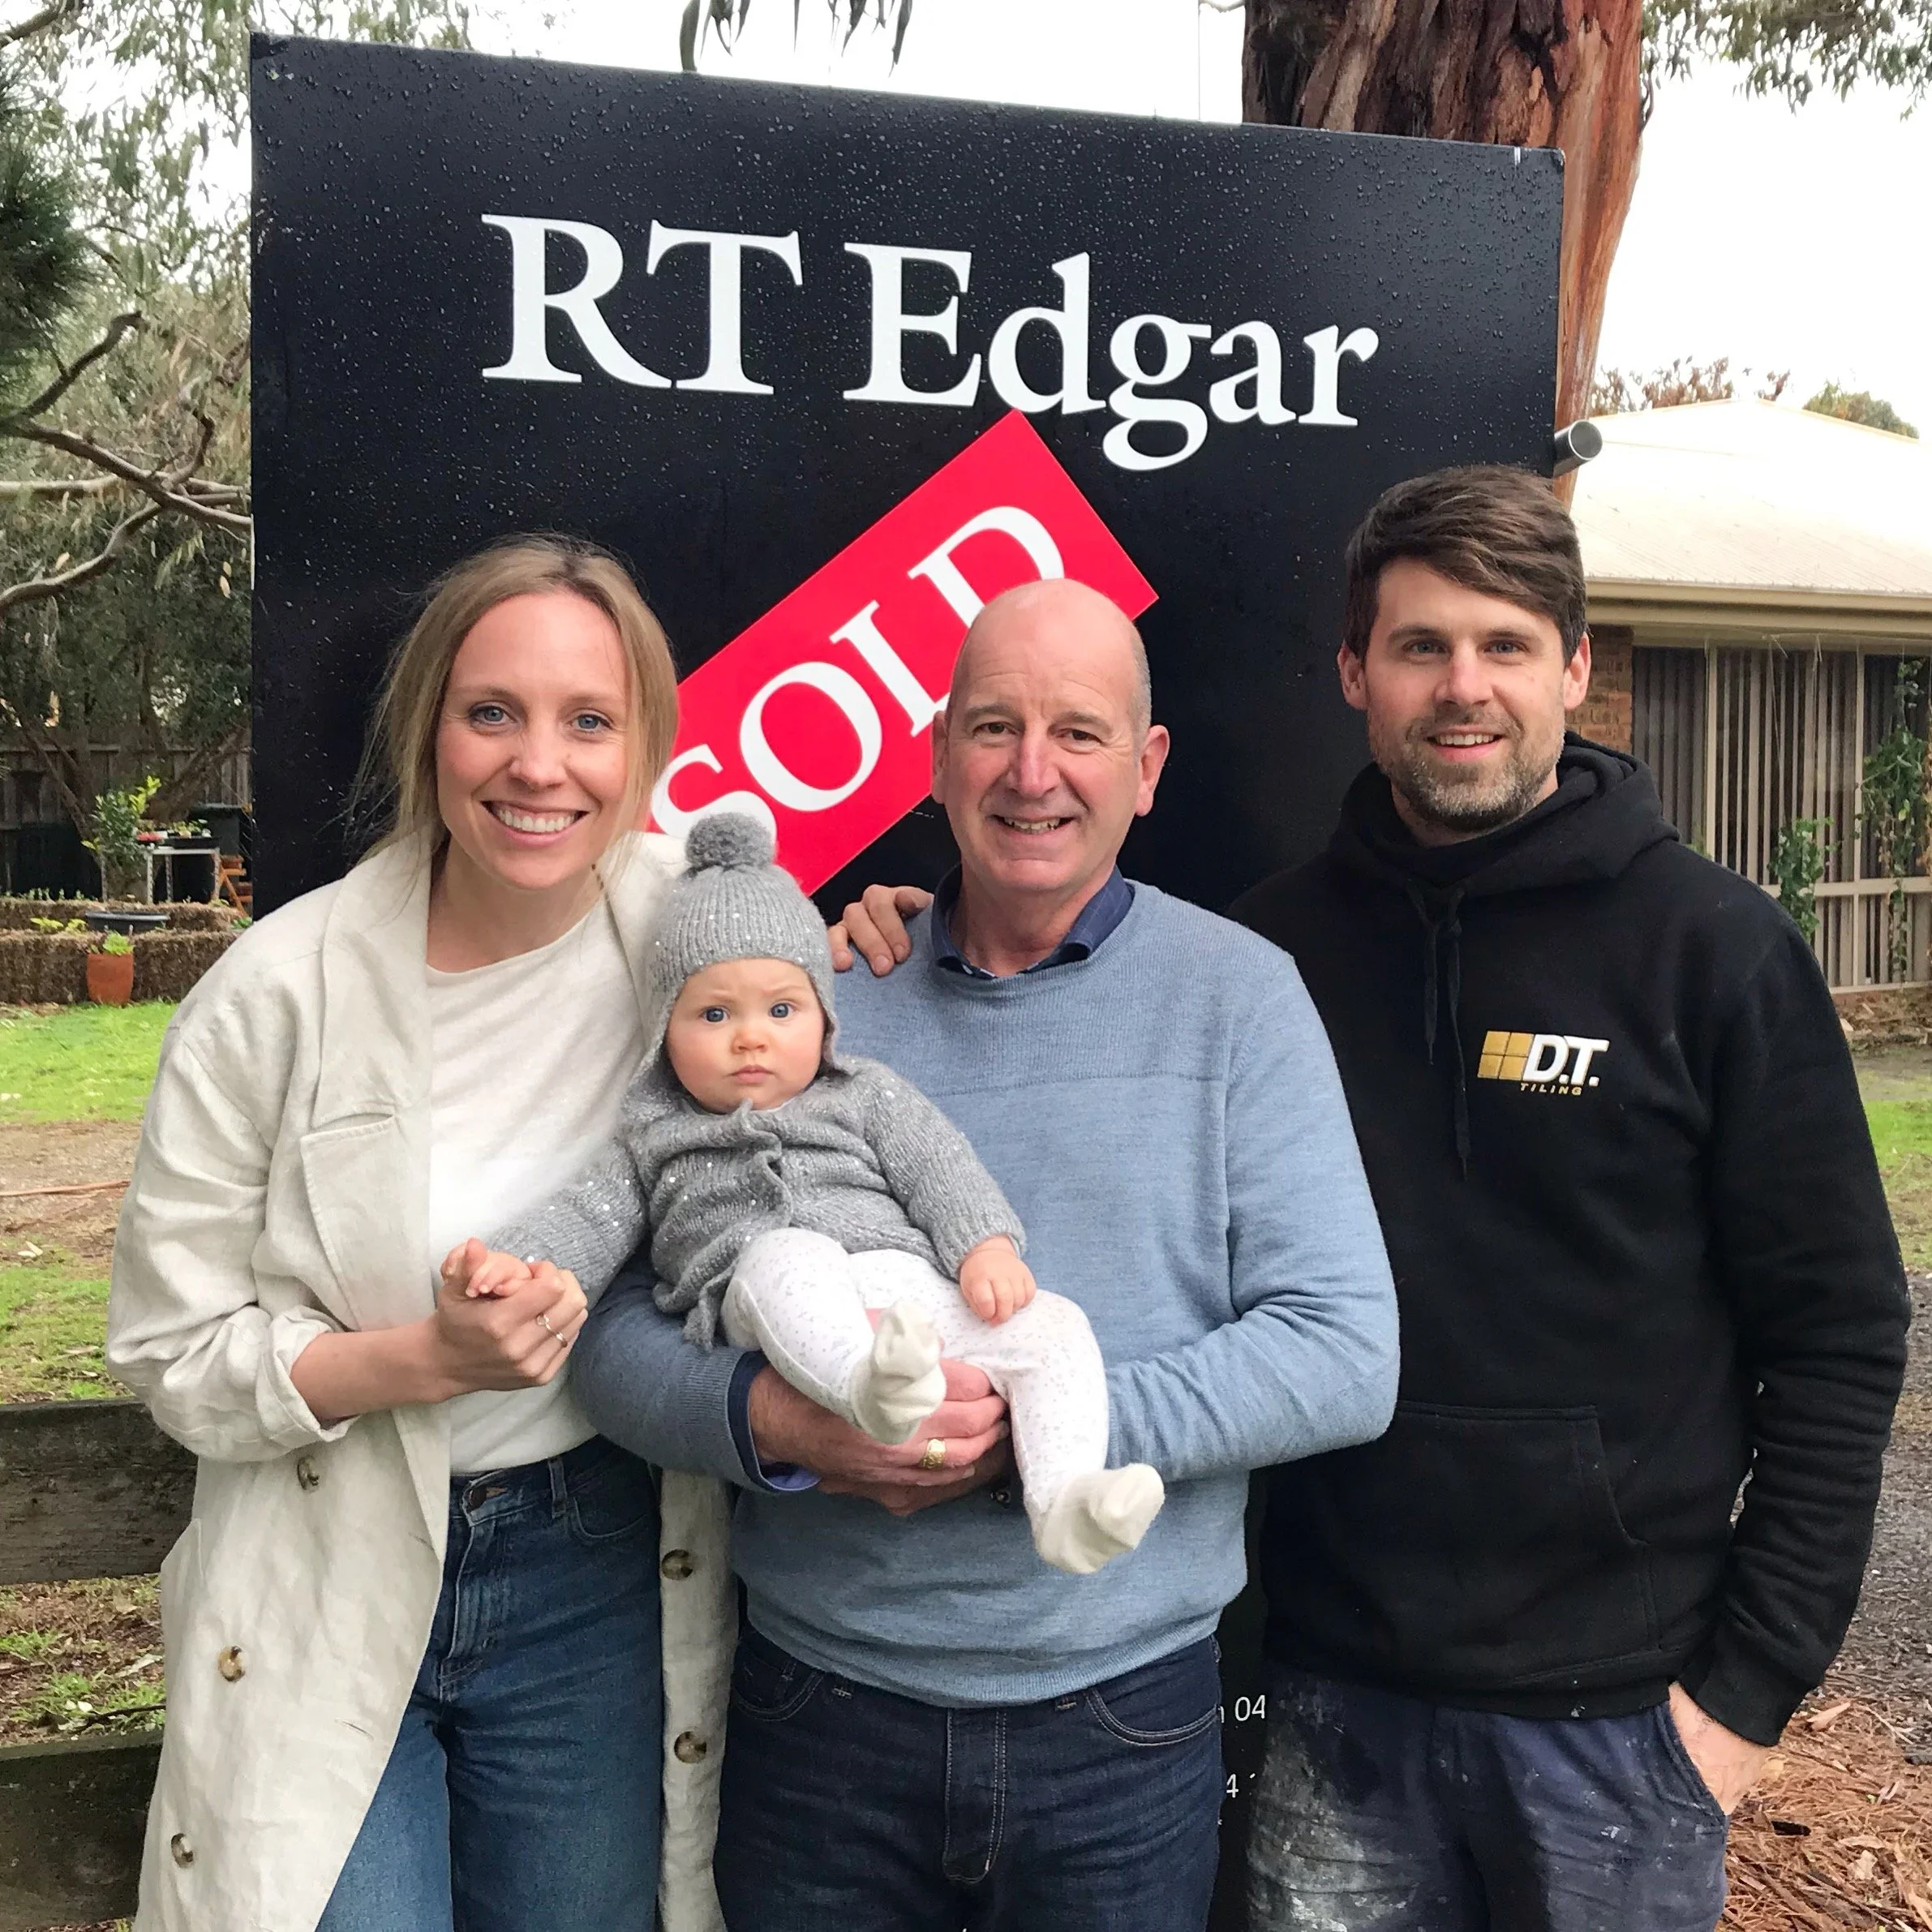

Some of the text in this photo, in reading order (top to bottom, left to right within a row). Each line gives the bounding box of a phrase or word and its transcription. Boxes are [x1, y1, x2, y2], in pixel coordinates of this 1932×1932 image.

[482, 213, 1379, 471] RT Edgar
[1522, 1033, 1610, 1087] D.T.
[1520, 1082, 1582, 1095] TILING
